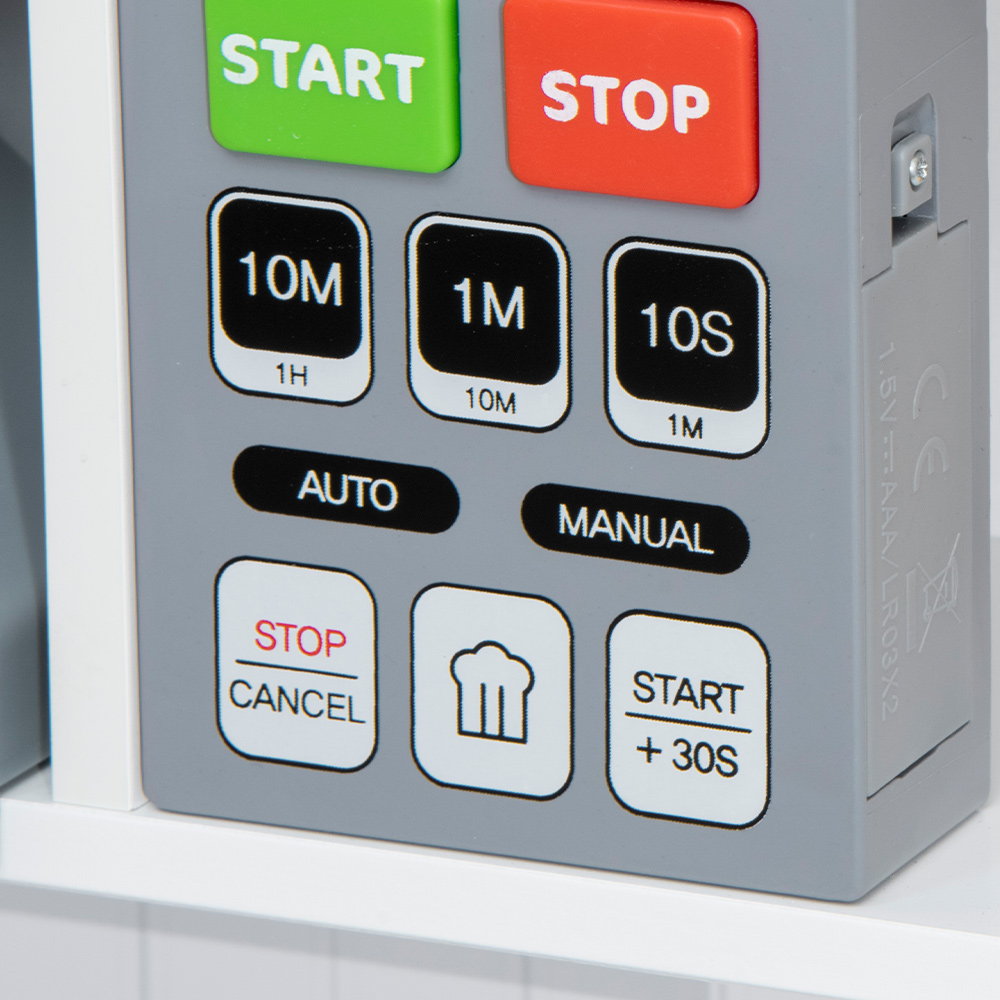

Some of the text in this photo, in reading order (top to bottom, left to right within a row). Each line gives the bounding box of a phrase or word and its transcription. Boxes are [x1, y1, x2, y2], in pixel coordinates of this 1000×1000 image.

[220, 33, 425, 104] START
[540, 69, 710, 134] STOP
[239, 251, 343, 307] 10M
[453, 277, 526, 330] 1M
[640, 301, 734, 357] 10S
[275, 361, 308, 387] 1H
[464, 387, 516, 415] 10M
[667, 414, 704, 440] 1M
[297, 469, 398, 512] AUTO
[558, 503, 715, 555] MANUAL
[254, 619, 347, 658] STOP
[229, 679, 366, 724] CANCEL
[632, 671, 744, 715] START
[672, 738, 739, 778] 30S
